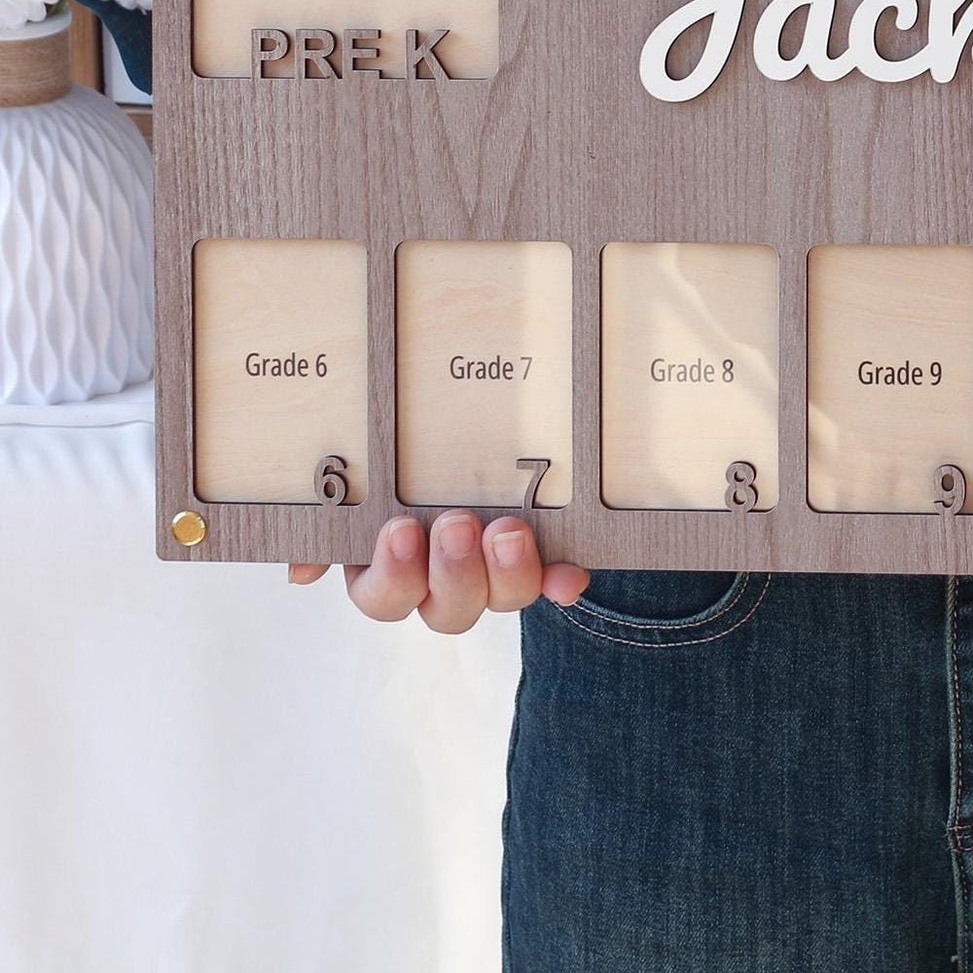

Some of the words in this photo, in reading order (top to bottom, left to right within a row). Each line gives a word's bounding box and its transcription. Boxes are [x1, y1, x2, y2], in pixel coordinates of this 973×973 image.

[251, 28, 381, 80] PRE
[406, 28, 453, 80] K
[245, 353, 310, 378] Grade
[315, 353, 328, 378] 6
[450, 356, 515, 381] Grade
[520, 356, 533, 381] 7
[650, 358, 716, 383] Grade
[721, 358, 735, 383] 8
[857, 360, 925, 387] Grade
[930, 360, 942, 387] 9
[314, 455, 349, 506] 6
[515, 458, 552, 510] 7
[724, 461, 758, 513] 8
[934, 464, 968, 516] 9
